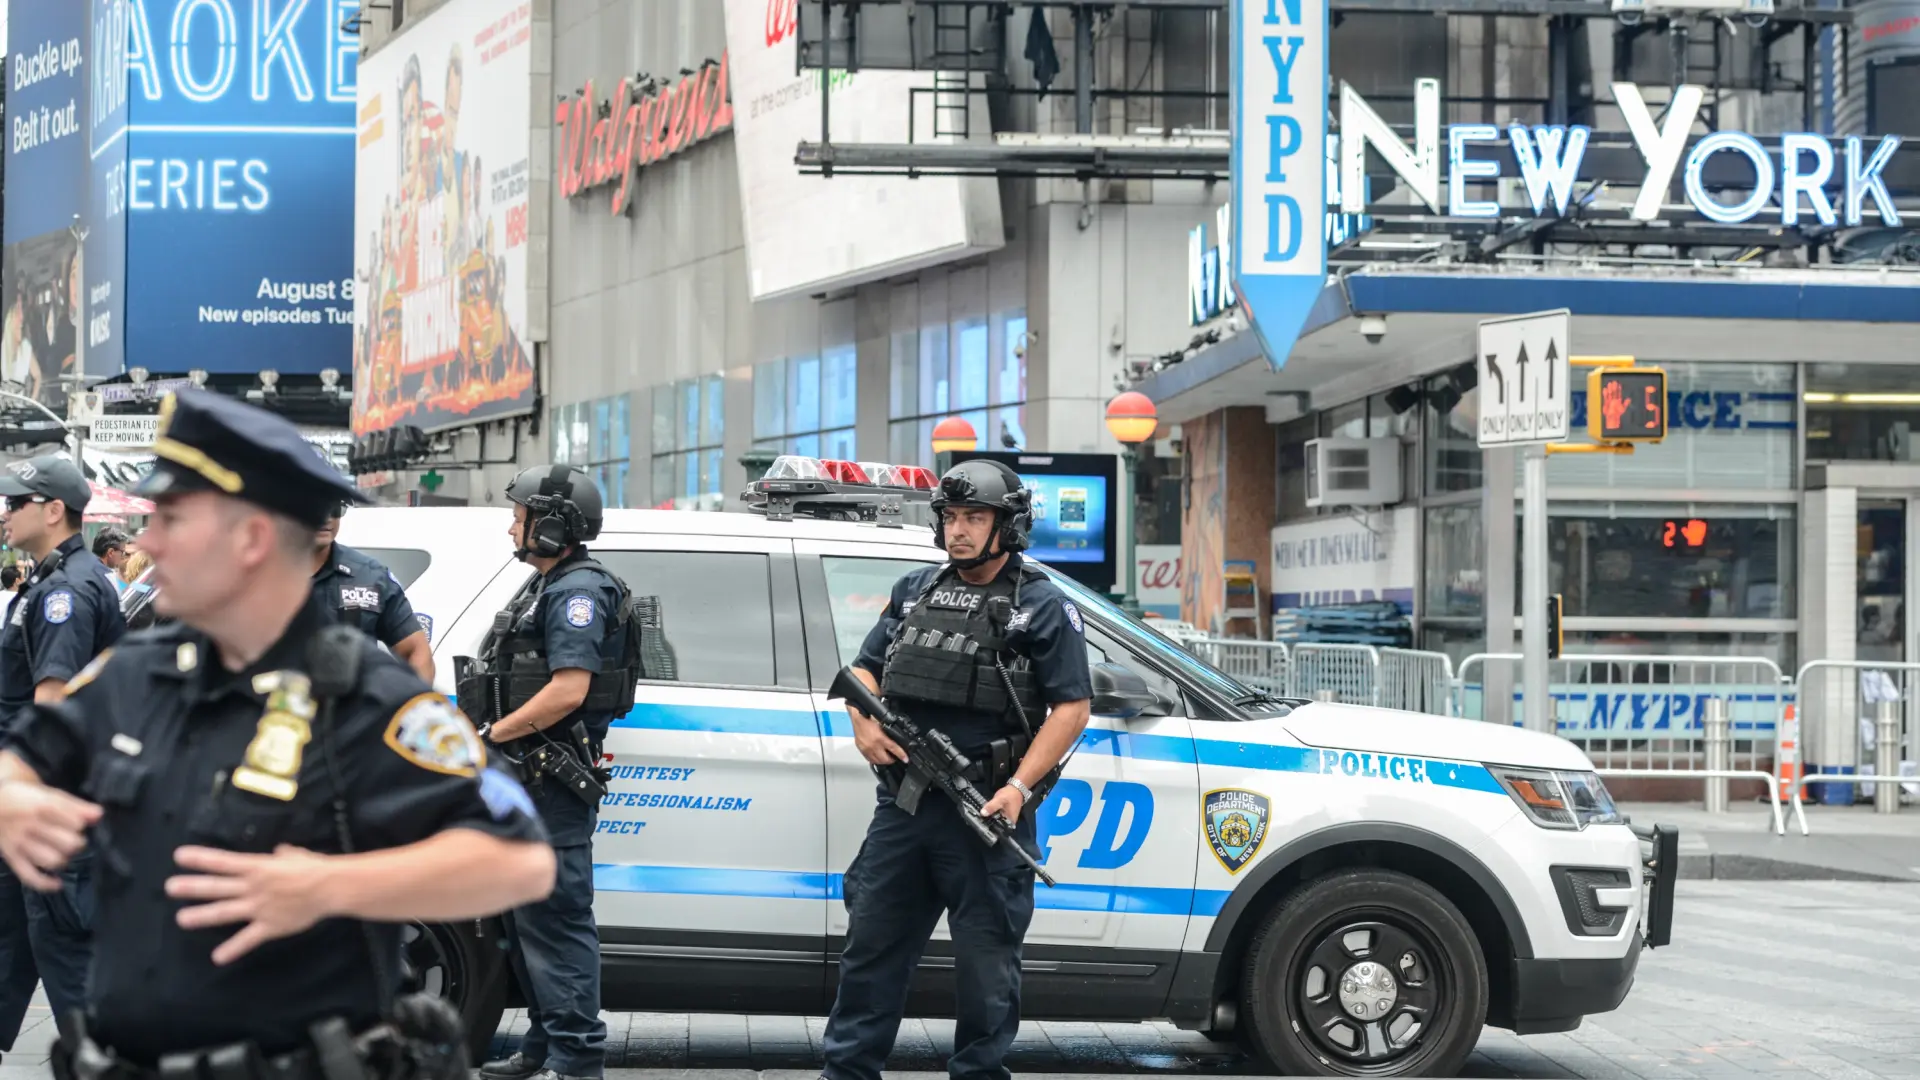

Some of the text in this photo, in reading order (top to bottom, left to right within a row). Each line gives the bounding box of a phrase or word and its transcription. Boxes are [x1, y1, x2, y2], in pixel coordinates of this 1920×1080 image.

[14, 37, 83, 91] Buckle up.
[13, 98, 80, 154] Belt it out.
[256, 278, 336, 303] August
[199, 306, 240, 323] New
[242, 306, 321, 326] episodes
[1645, 385, 1660, 429] 5
[94, 419, 141, 430] PEDESTRIAN
[1482, 411, 1564, 435] ONLY ONLY ONLY
[94, 432, 145, 443] KEEP MOVING
[341, 589, 379, 604] POLICE
[930, 591, 981, 609] POLICE
[1322, 749, 1424, 783] POLICE
[600, 792, 752, 811] OFESSIONALISM
[1219, 791, 1256, 804] POLICE
[1206, 800, 1266, 818] DEPARTMENT
[595, 820, 646, 835] PECT
[1036, 778, 1155, 870] PD
[1207, 823, 1227, 858] CITY OF
[1238, 821, 1266, 863] NEW YORK
